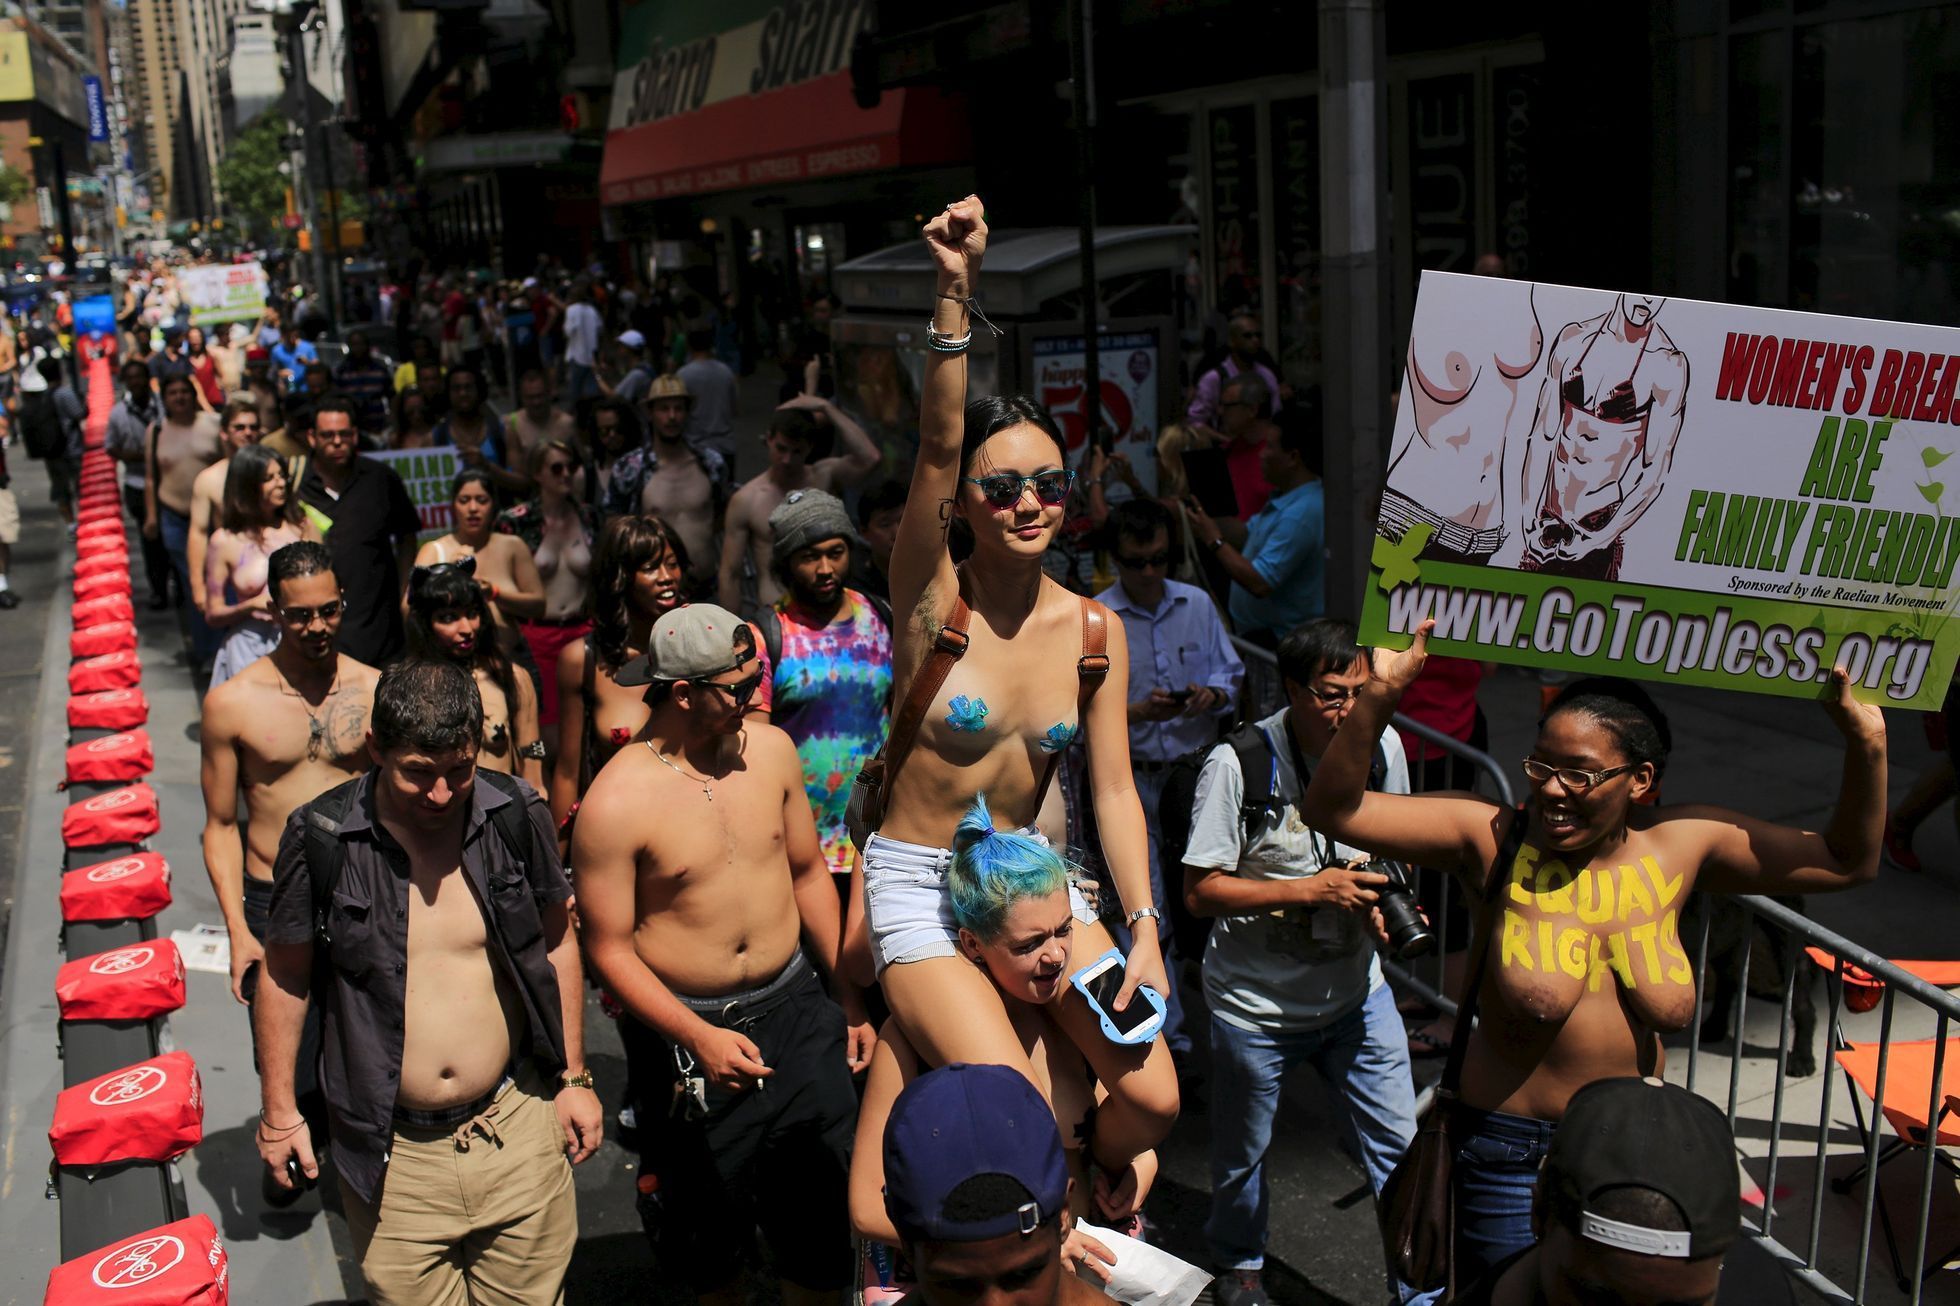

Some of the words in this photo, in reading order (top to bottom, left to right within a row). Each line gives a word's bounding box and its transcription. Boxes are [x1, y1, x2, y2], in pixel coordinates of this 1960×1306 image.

[627, 35, 717, 128] sbarro
[806, 143, 881, 174] ESPRESSO
[1042, 366, 1089, 385] happ
[1716, 332, 1875, 415] WOMEN'S
[1799, 415, 1893, 504] ARE
[1675, 489, 1811, 573] FAMILY
[1800, 503, 1960, 590] FRIENDLY
[1727, 575, 1794, 596] Sponsored
[1793, 582, 1809, 599] by
[1810, 584, 1831, 600] the
[1832, 586, 1881, 605] Raelian
[1881, 591, 1947, 611] Movement
[1387, 582, 1935, 700] www.GoTopless.org
[1510, 842, 1684, 924] EQUAL
[1502, 907, 1692, 992] RIGHTS
